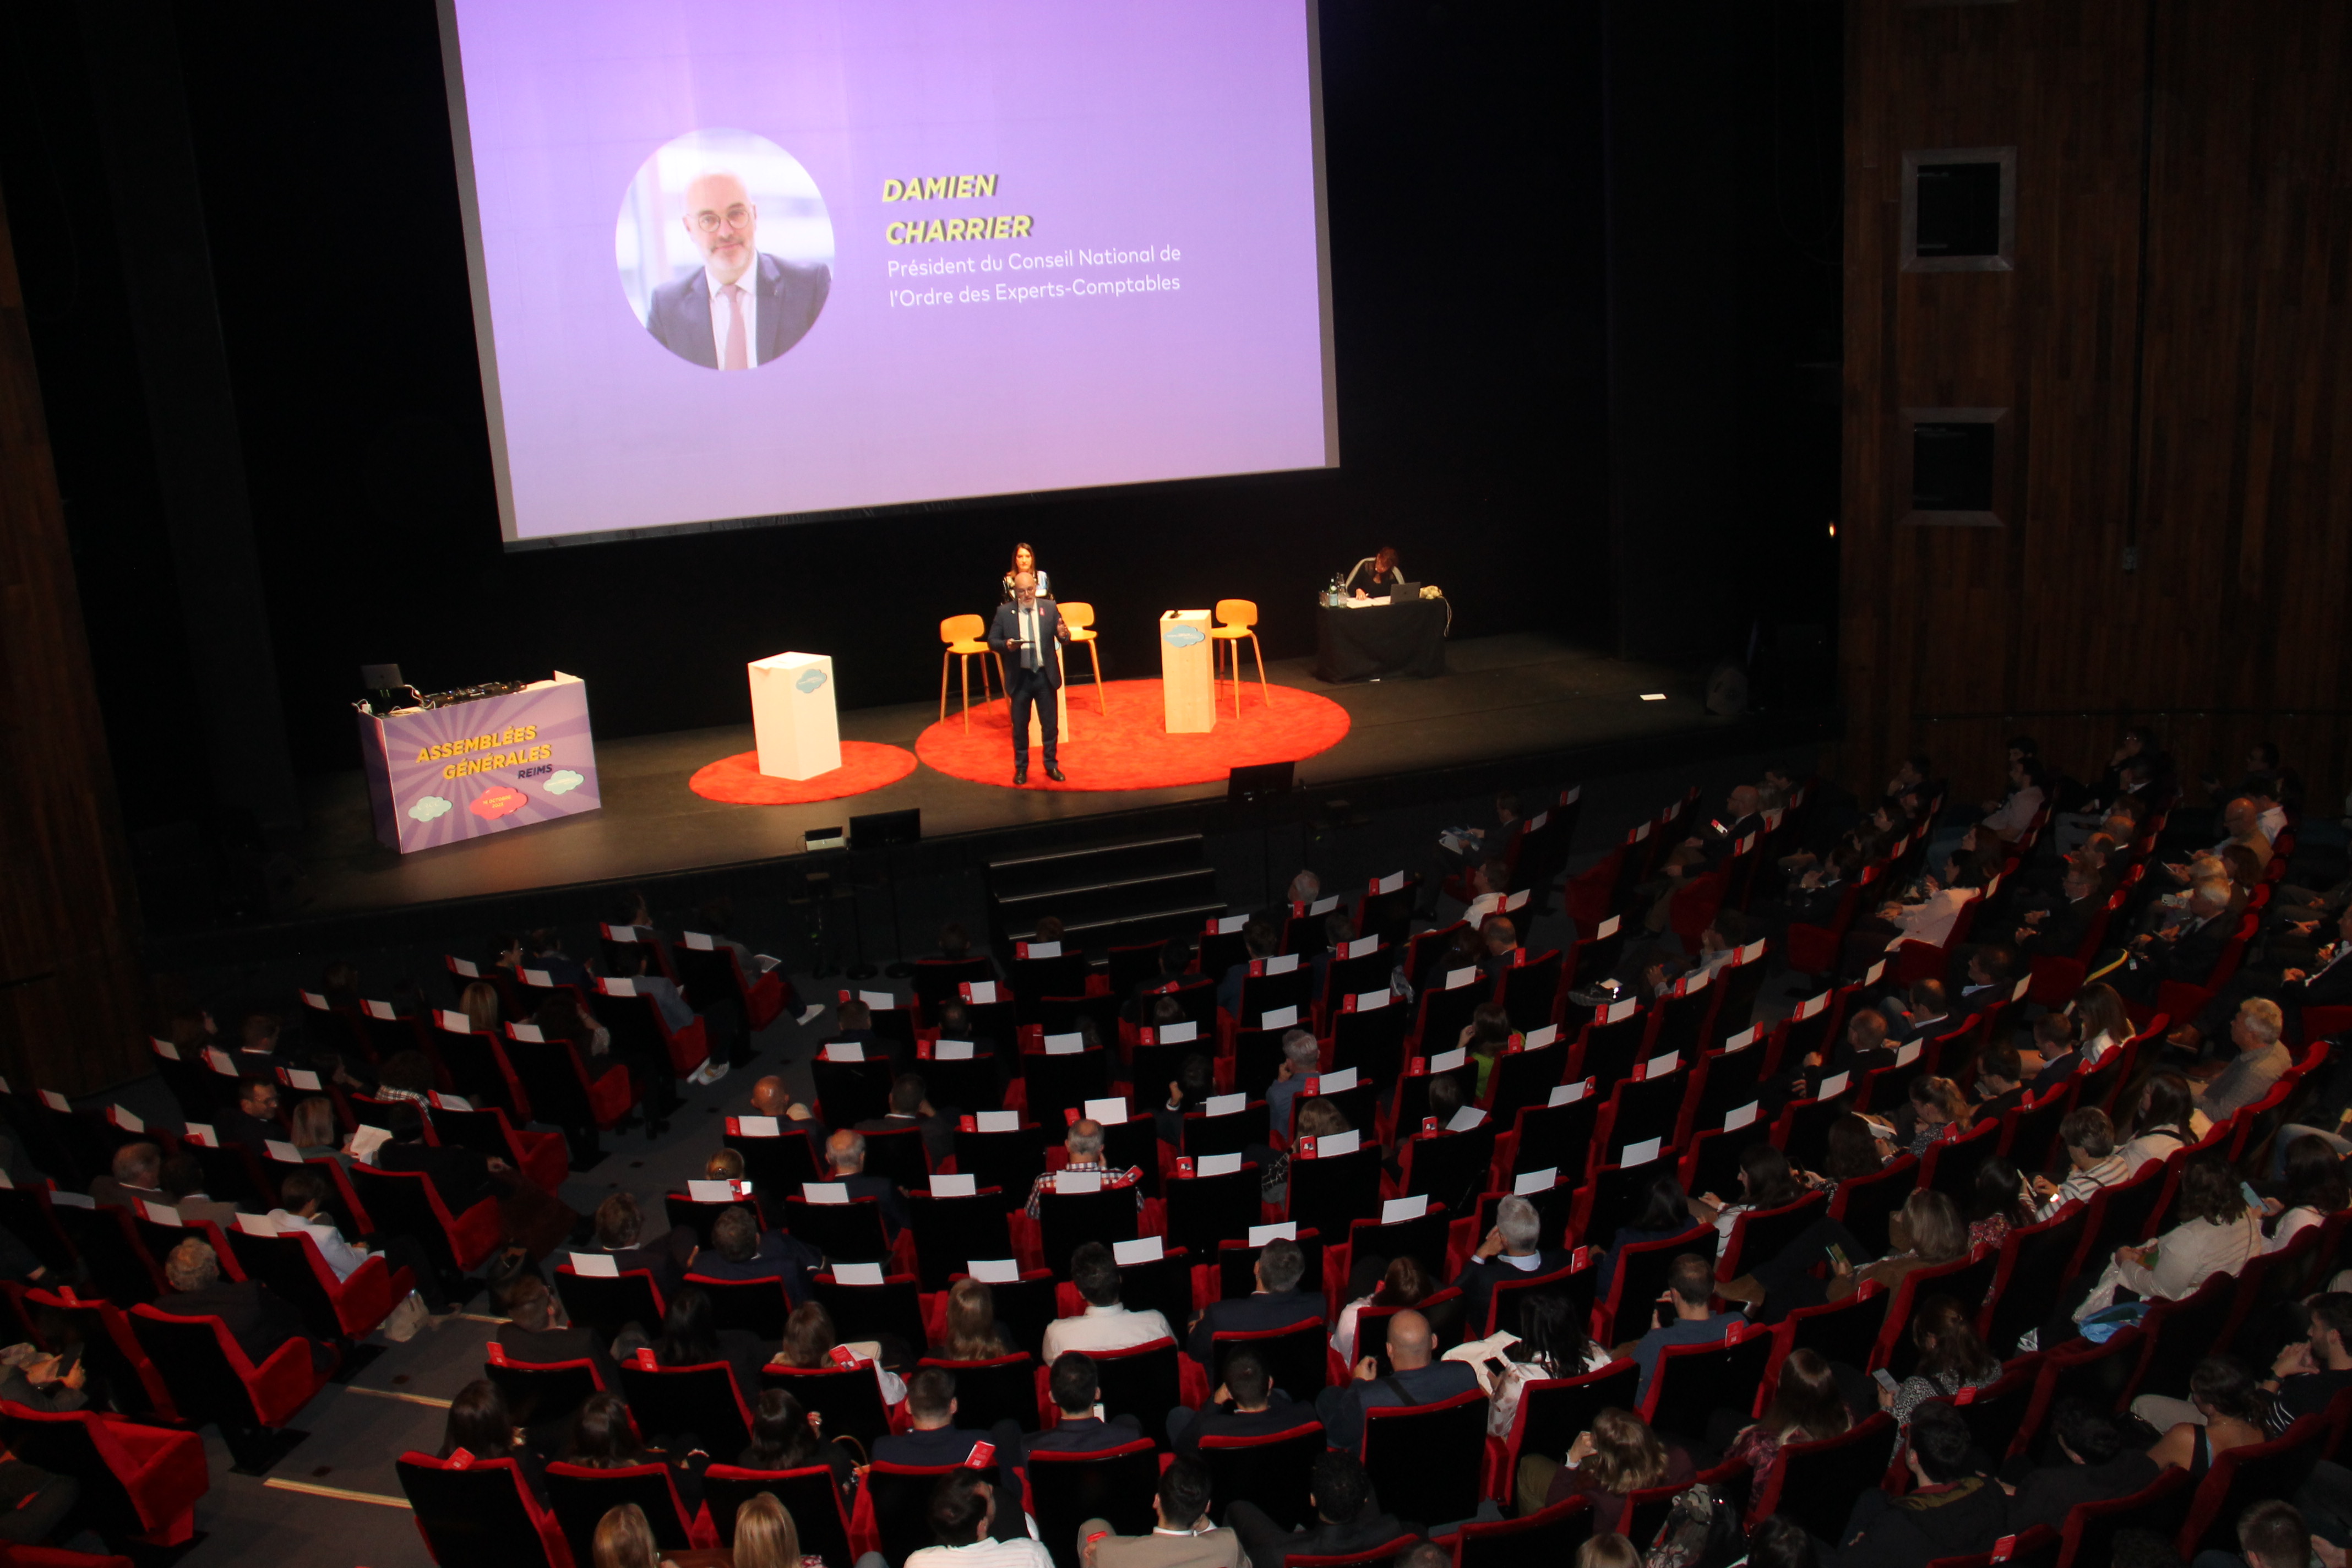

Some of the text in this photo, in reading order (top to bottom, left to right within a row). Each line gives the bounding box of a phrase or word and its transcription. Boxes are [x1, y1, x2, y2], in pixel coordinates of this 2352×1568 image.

[882, 174, 998, 202] DAMIEN
[885, 215, 1034, 245] CHARRIER
[888, 244, 1181, 277] Président du Conseil National de
[890, 273, 1180, 307] l'Ordre des Experts-Comptables
[416, 725, 537, 764] ASSEMBLÉES
[443, 744, 552, 780] GÉNÉRALES
[518, 764, 552, 779] REIMS
